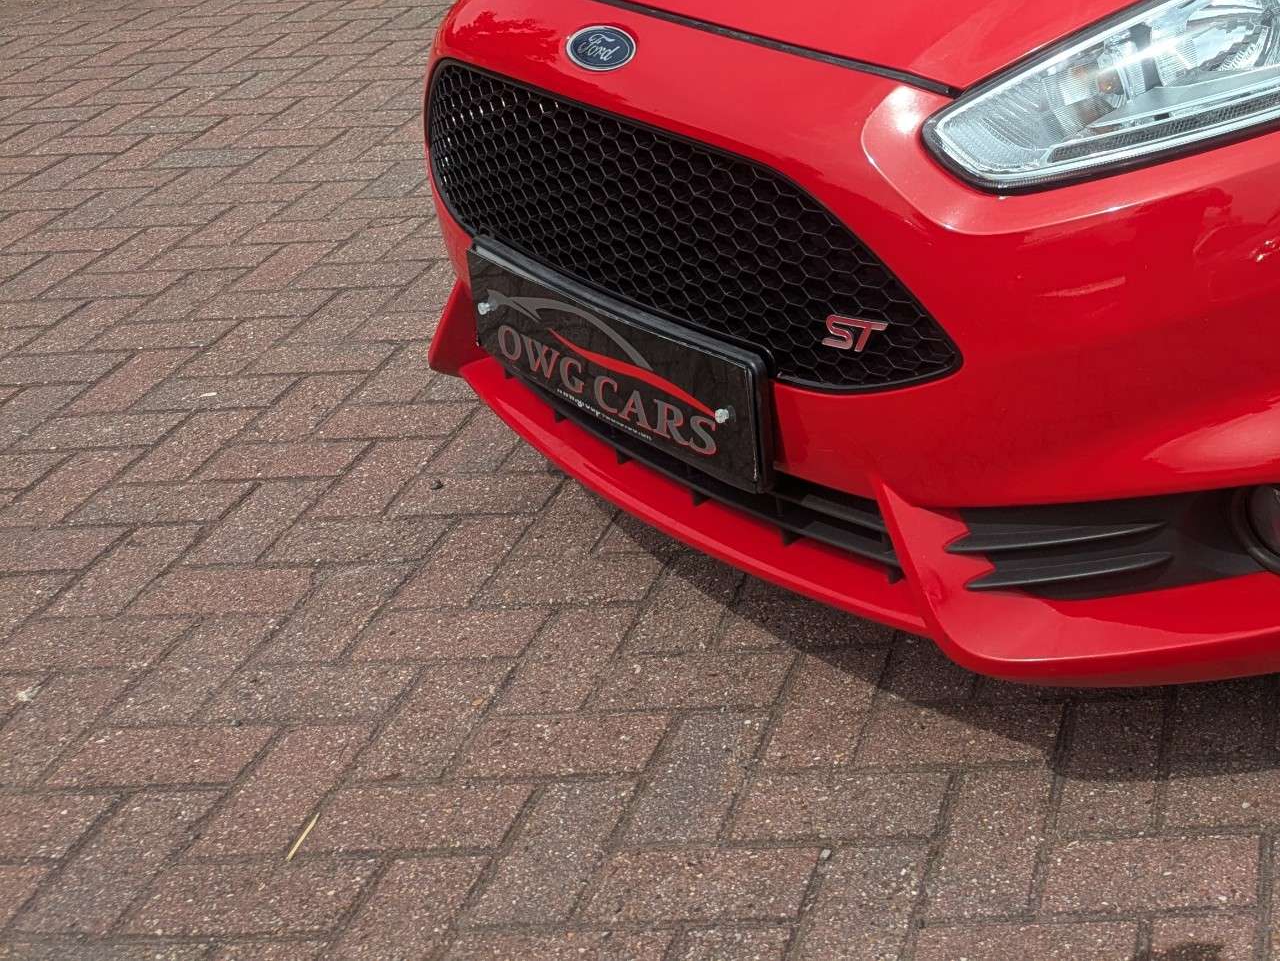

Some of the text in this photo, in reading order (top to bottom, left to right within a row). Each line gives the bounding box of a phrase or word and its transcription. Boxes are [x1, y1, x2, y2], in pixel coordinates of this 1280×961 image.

[577, 33, 620, 61] Ford
[822, 314, 888, 353] ST
[498, 325, 584, 393] OWG
[594, 376, 717, 455] CARS
